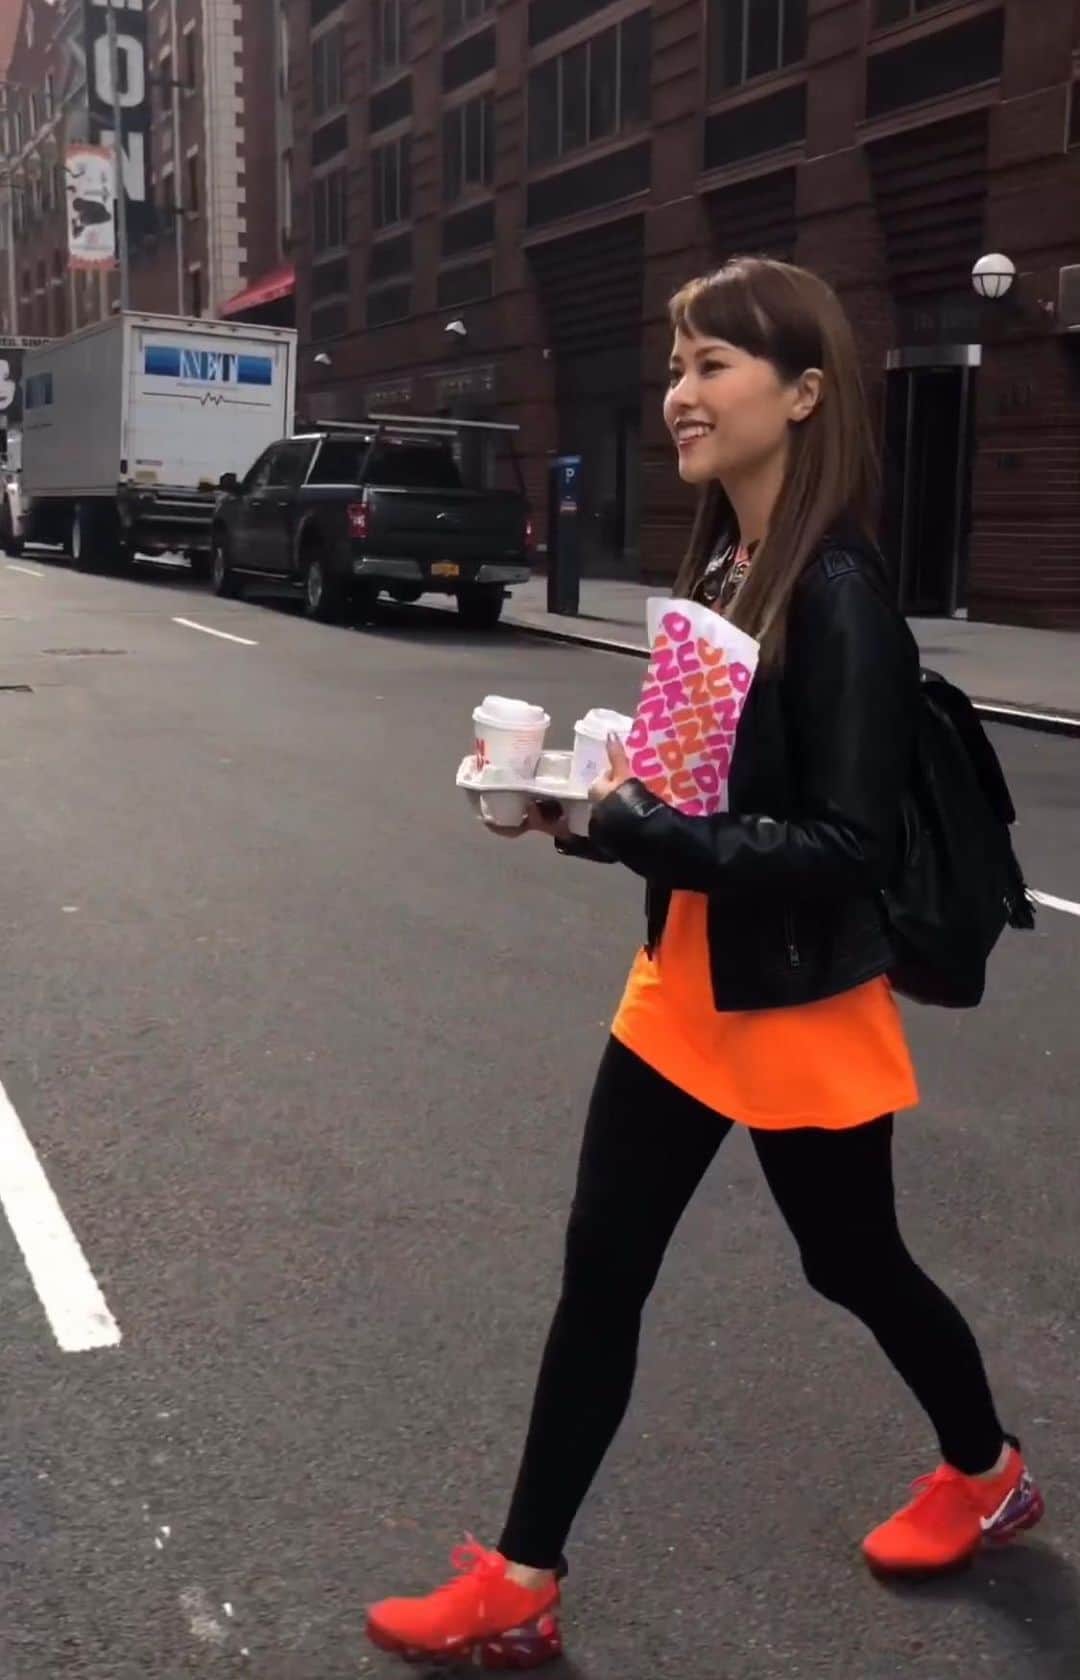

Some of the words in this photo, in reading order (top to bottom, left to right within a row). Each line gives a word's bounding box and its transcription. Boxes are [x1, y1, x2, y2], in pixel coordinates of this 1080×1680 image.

[92, 0, 146, 201] ON
[180, 350, 237, 382] NET
[565, 467, 575, 484] P
